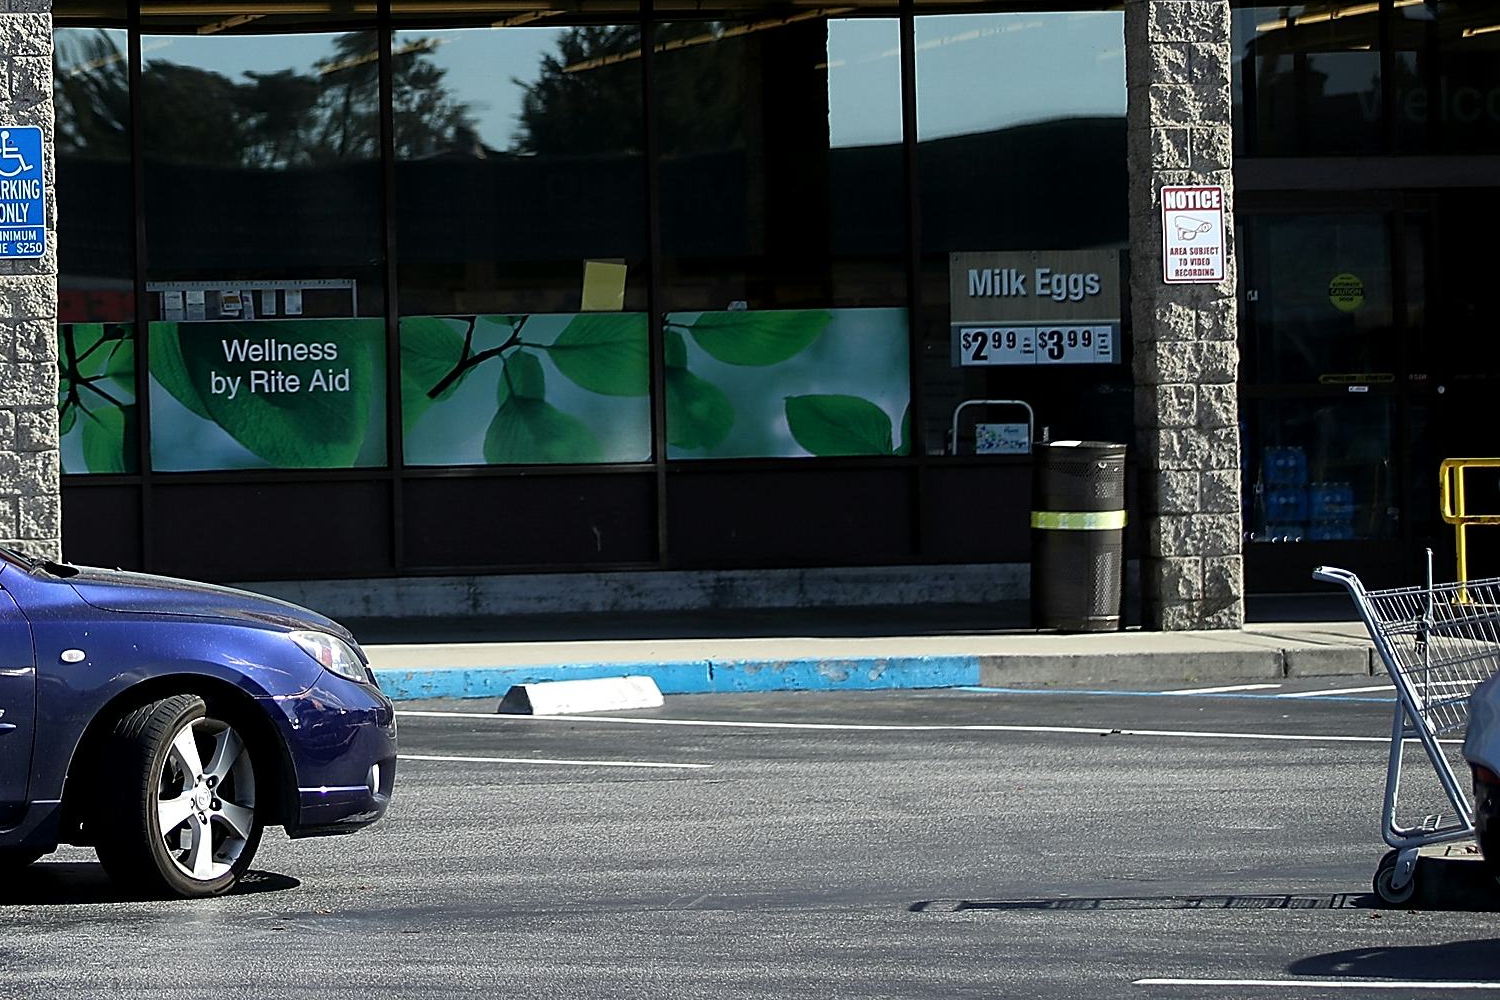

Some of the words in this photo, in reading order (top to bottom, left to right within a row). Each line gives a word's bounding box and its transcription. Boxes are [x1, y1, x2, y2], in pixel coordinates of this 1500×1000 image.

[1165, 191, 1220, 209] NOTICE
[1170, 247, 1188, 255] AREA
[1189, 247, 1219, 255] SUBJECT
[1179, 258, 1188, 266] TO
[1190, 258, 1211, 266] VIDEO
[1175, 268, 1215, 277] RECORDING
[968, 268, 1027, 296] Milk
[1035, 268, 1100, 301] Eggs
[222, 339, 338, 362] Wellness
[211, 371, 241, 400] by
[250, 370, 300, 393] Rite
[308, 368, 350, 392] Aid
